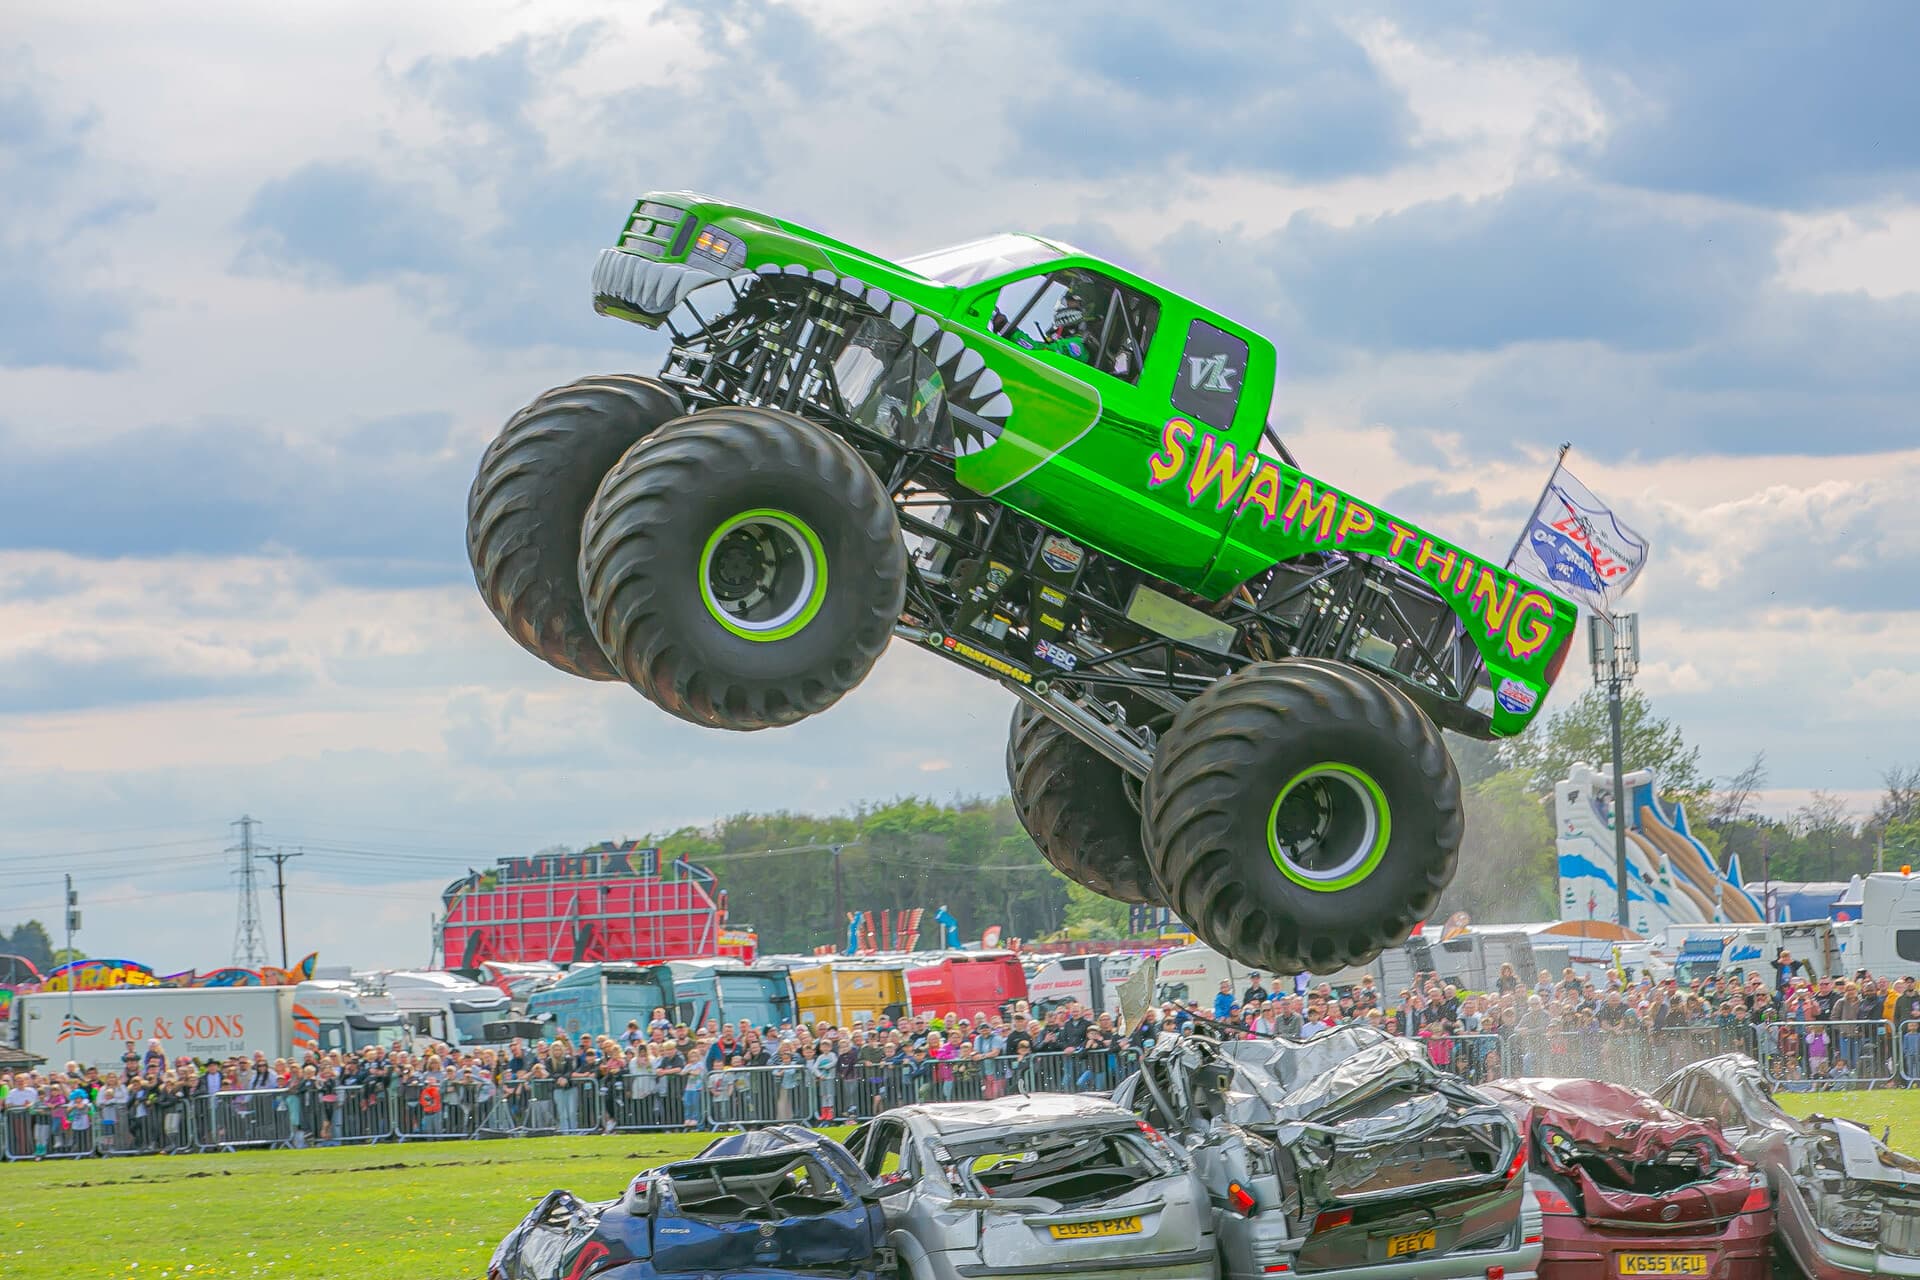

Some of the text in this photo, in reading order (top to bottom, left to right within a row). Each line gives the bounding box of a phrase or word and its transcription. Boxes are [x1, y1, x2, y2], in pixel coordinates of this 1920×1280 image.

[1150, 417, 1554, 659] SWAMP THING
[1047, 643, 1077, 667] EBC
[109, 1014, 245, 1041] AG & SONS
[1103, 1215, 1136, 1232] PXK
[1626, 1256, 1701, 1272] K655 KEU
